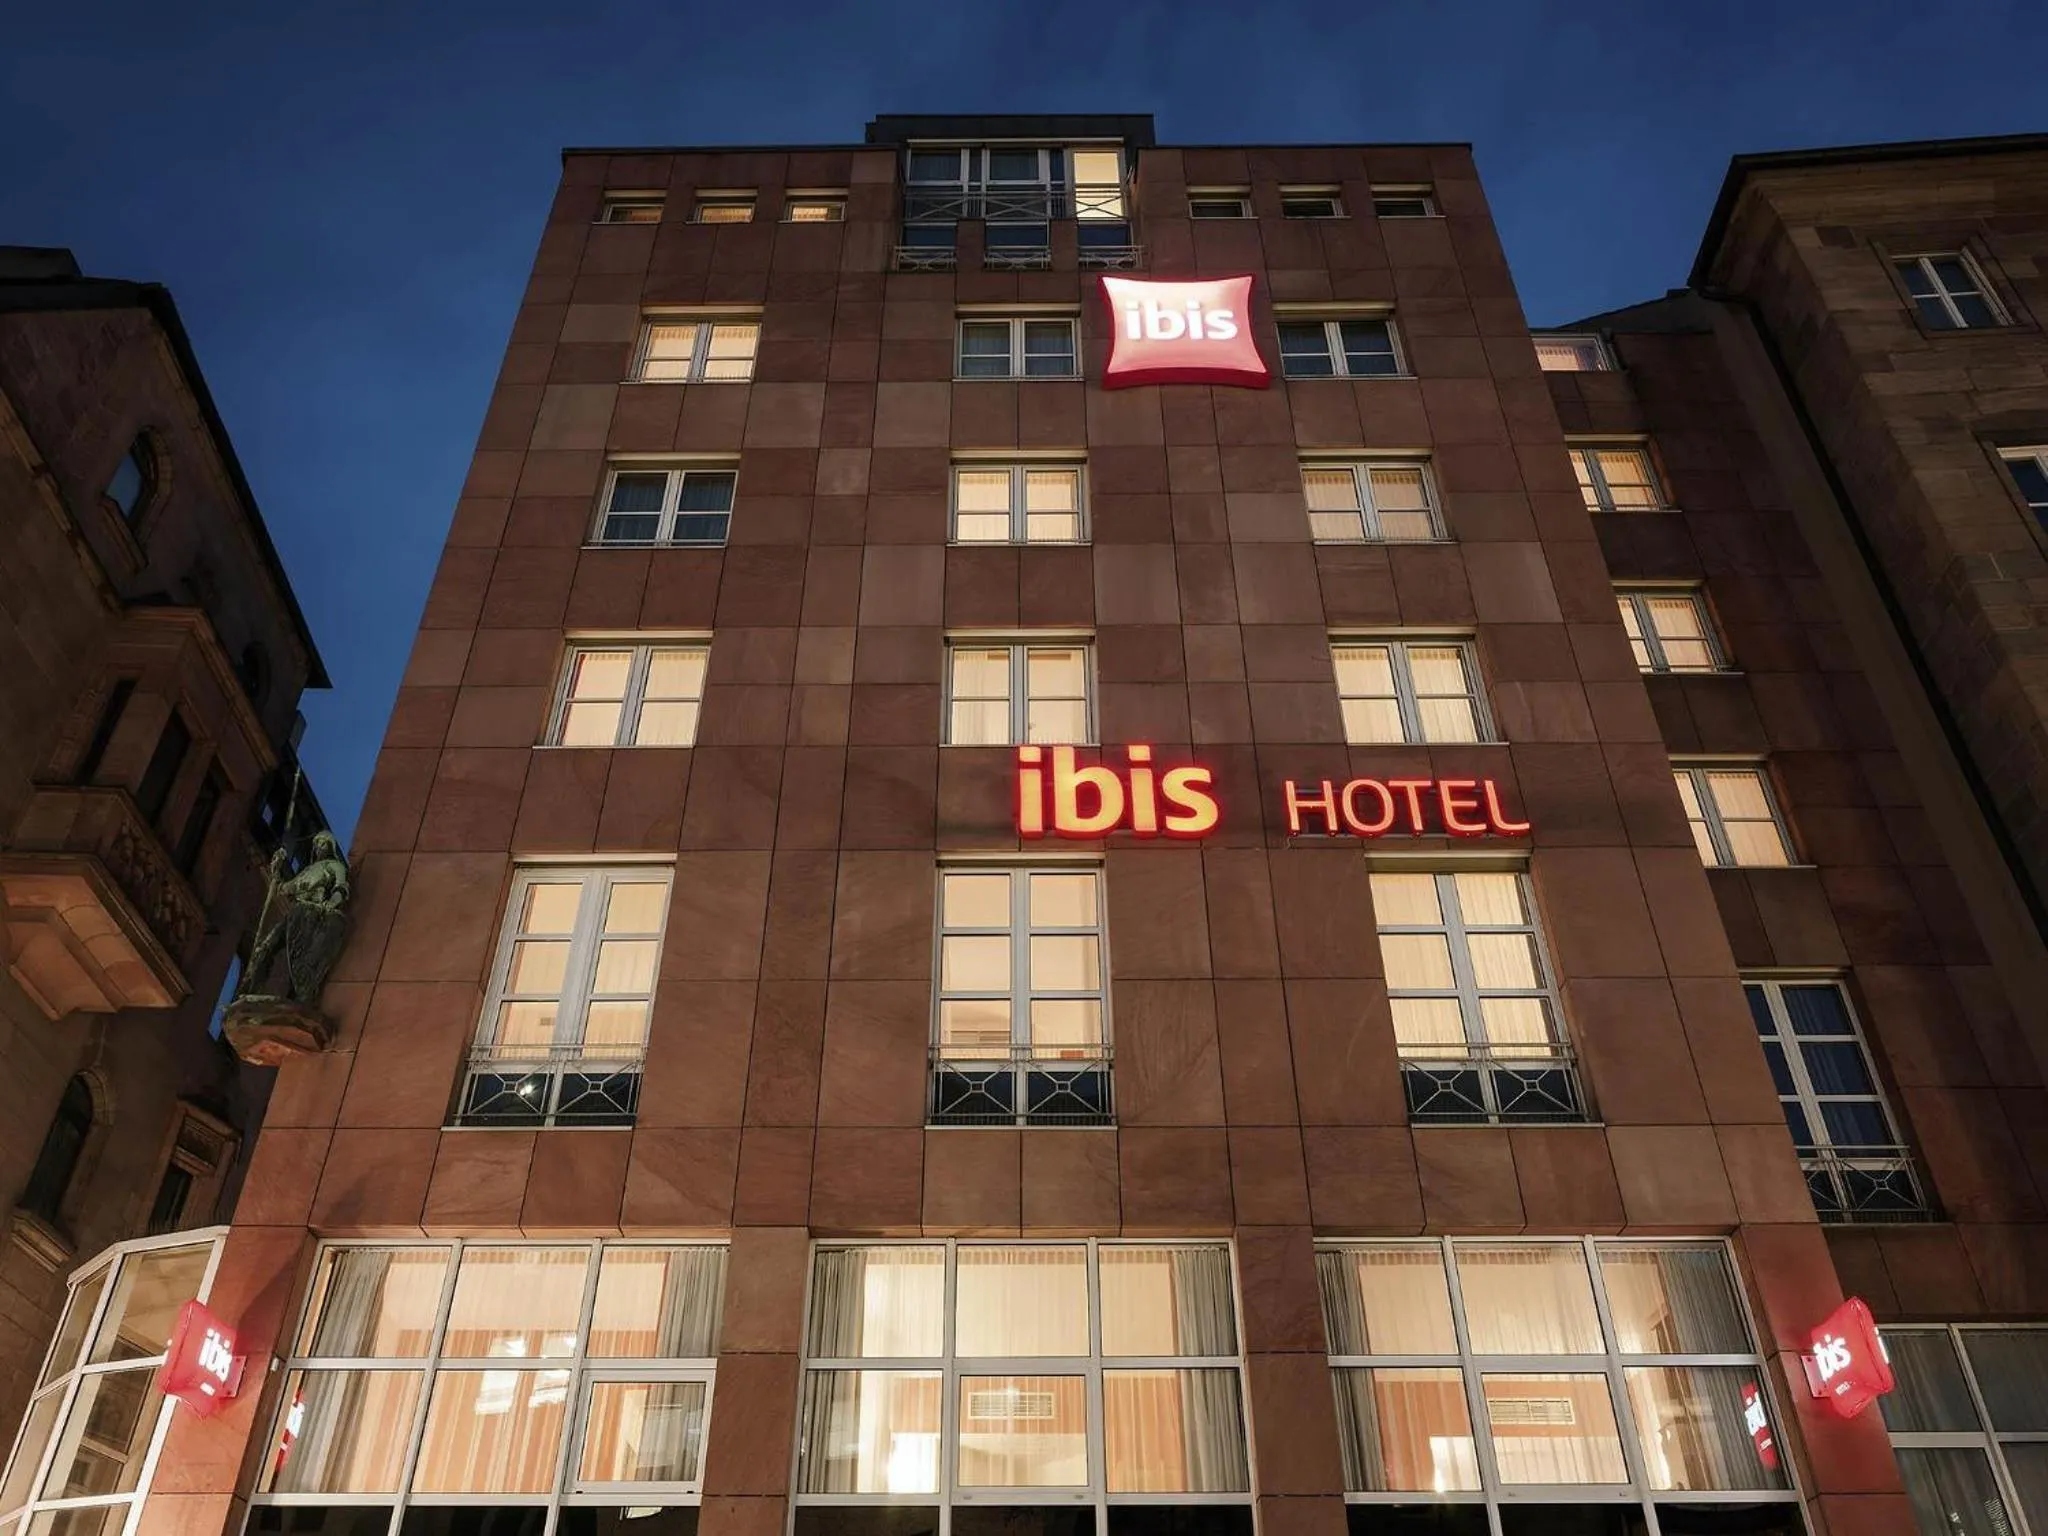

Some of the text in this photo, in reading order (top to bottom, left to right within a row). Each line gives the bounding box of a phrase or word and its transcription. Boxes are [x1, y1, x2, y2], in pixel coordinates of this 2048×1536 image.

[1124, 299, 1238, 341] ibis
[1017, 744, 1530, 835] ibis HOTEL
